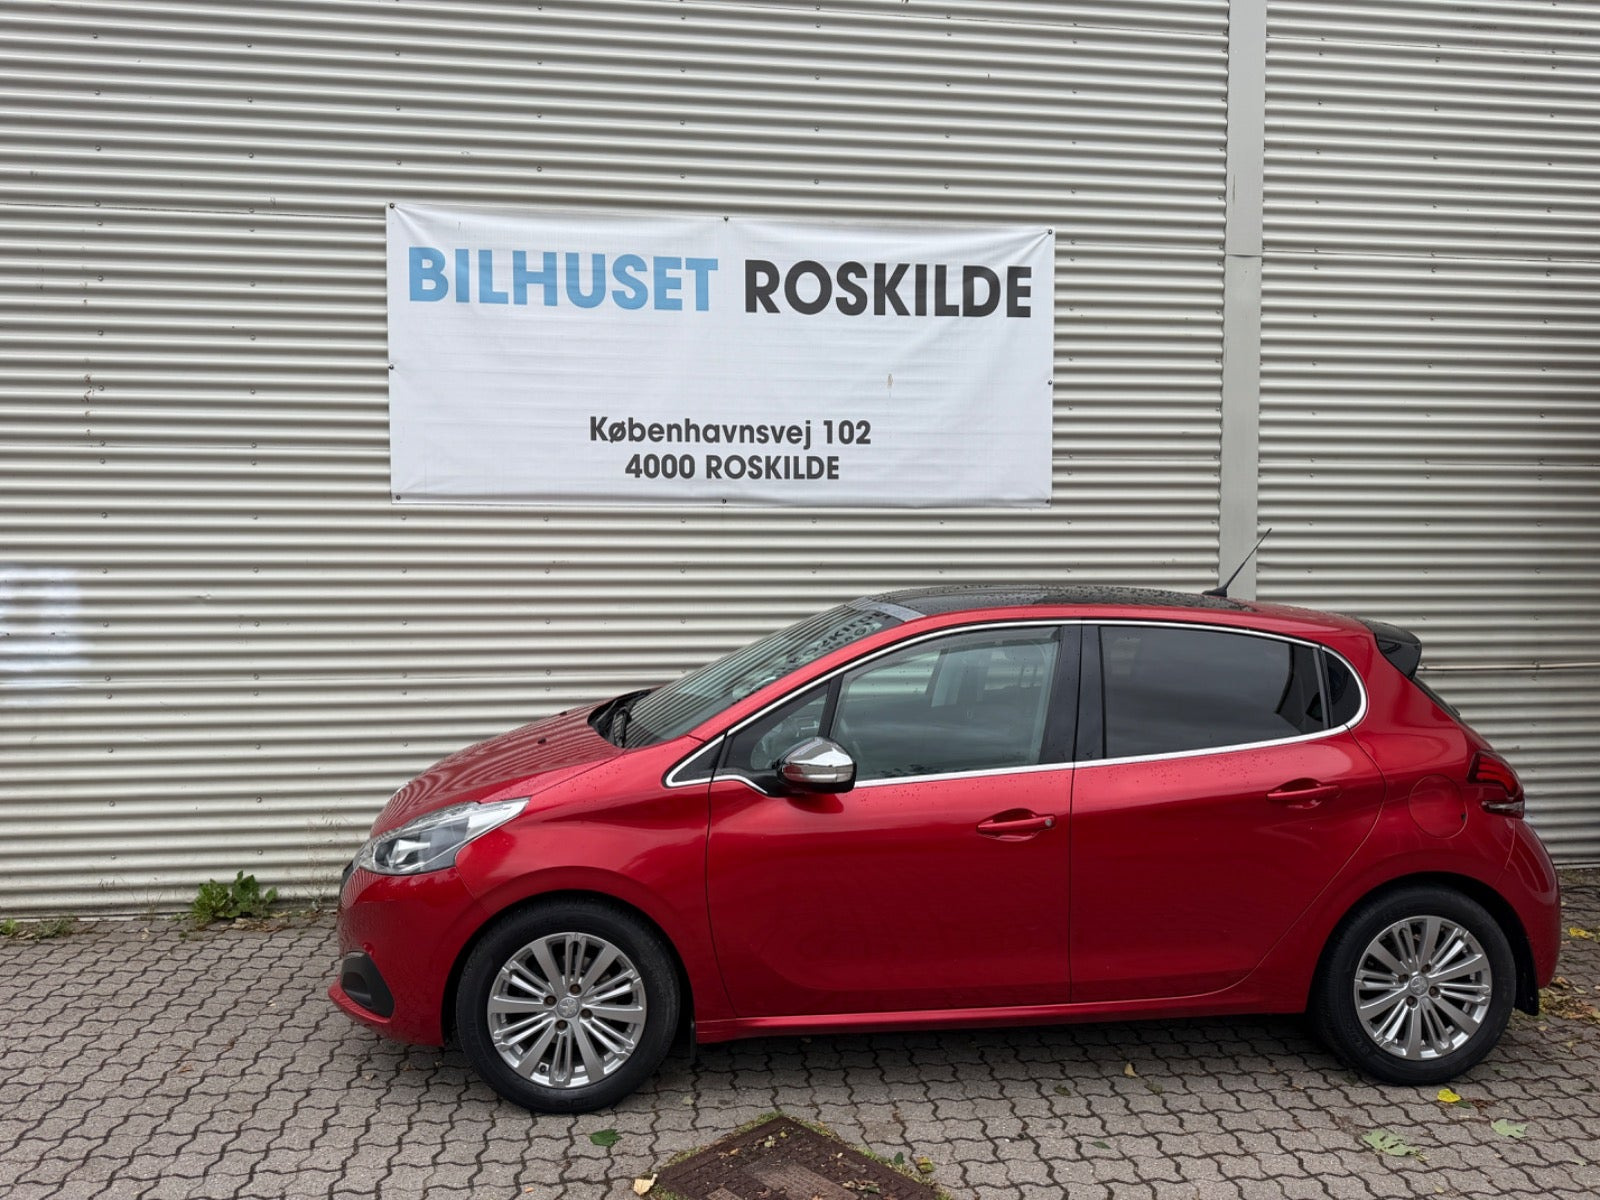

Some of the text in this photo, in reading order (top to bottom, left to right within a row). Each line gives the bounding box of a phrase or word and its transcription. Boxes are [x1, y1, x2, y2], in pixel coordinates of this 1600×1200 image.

[408, 246, 1032, 318] BILHUSET ROSKILDE
[590, 415, 872, 451] Københavnsvej 102
[624, 453, 840, 480] 4000 ROSKILDE
